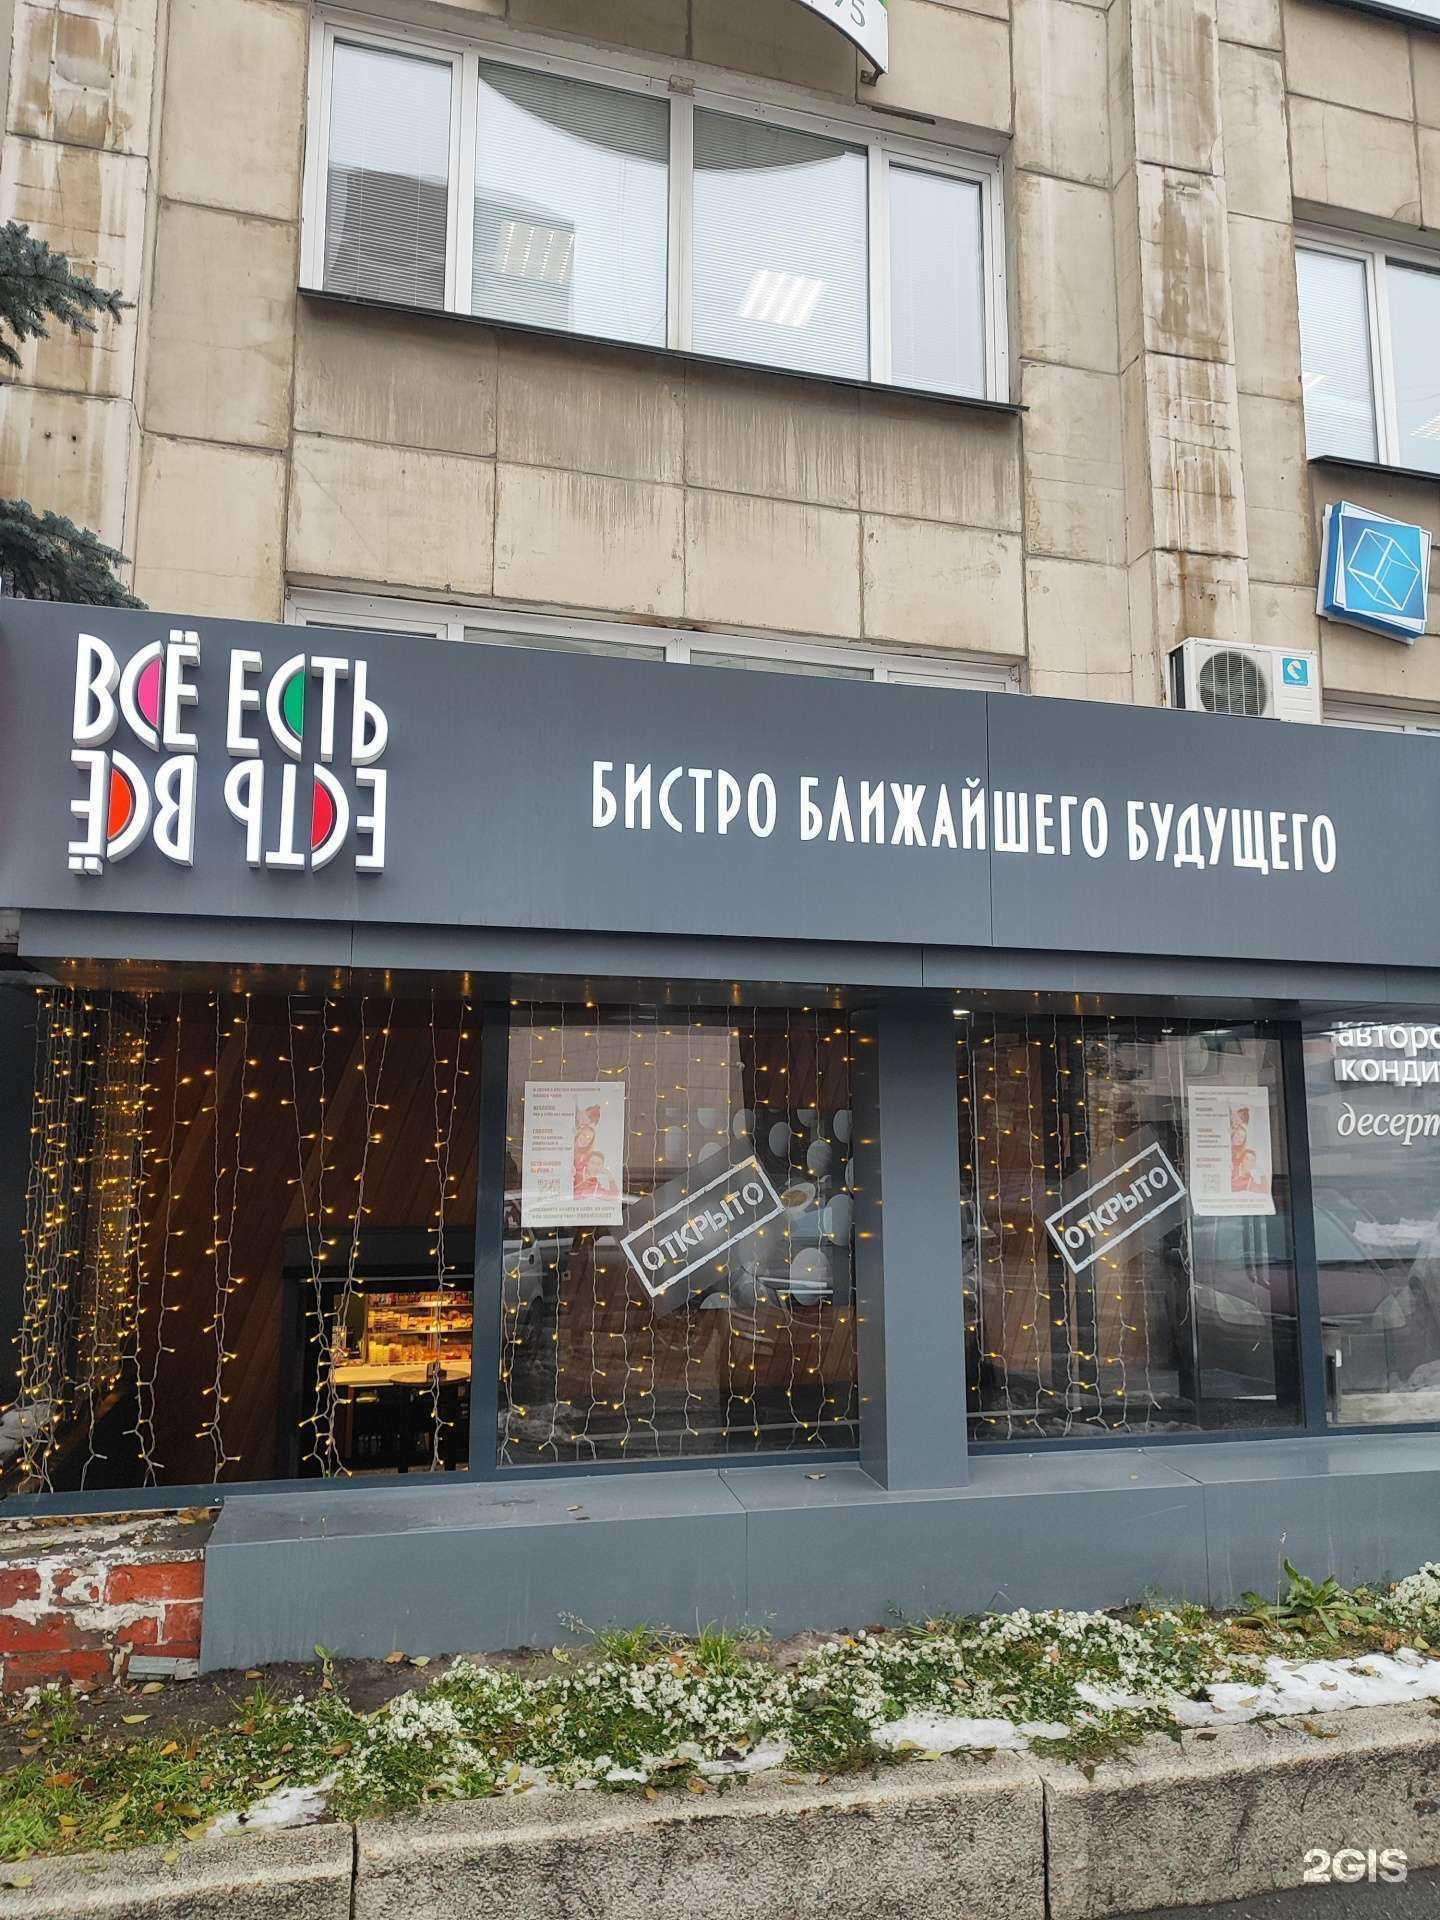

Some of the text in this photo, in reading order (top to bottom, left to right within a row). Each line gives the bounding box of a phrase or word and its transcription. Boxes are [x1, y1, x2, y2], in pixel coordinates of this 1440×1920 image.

[72, 629, 389, 766] ВСЁ ЕСТЬ
[592, 760, 1337, 875] БИСТРО БЛИЖАЙШЕГО БУДУЩЕГО
[1336, 1059, 1440, 1087] конди
[641, 1182, 764, 1271] ОТКРЫТО
[1064, 1166, 1168, 1249] ОТКРЫТО
